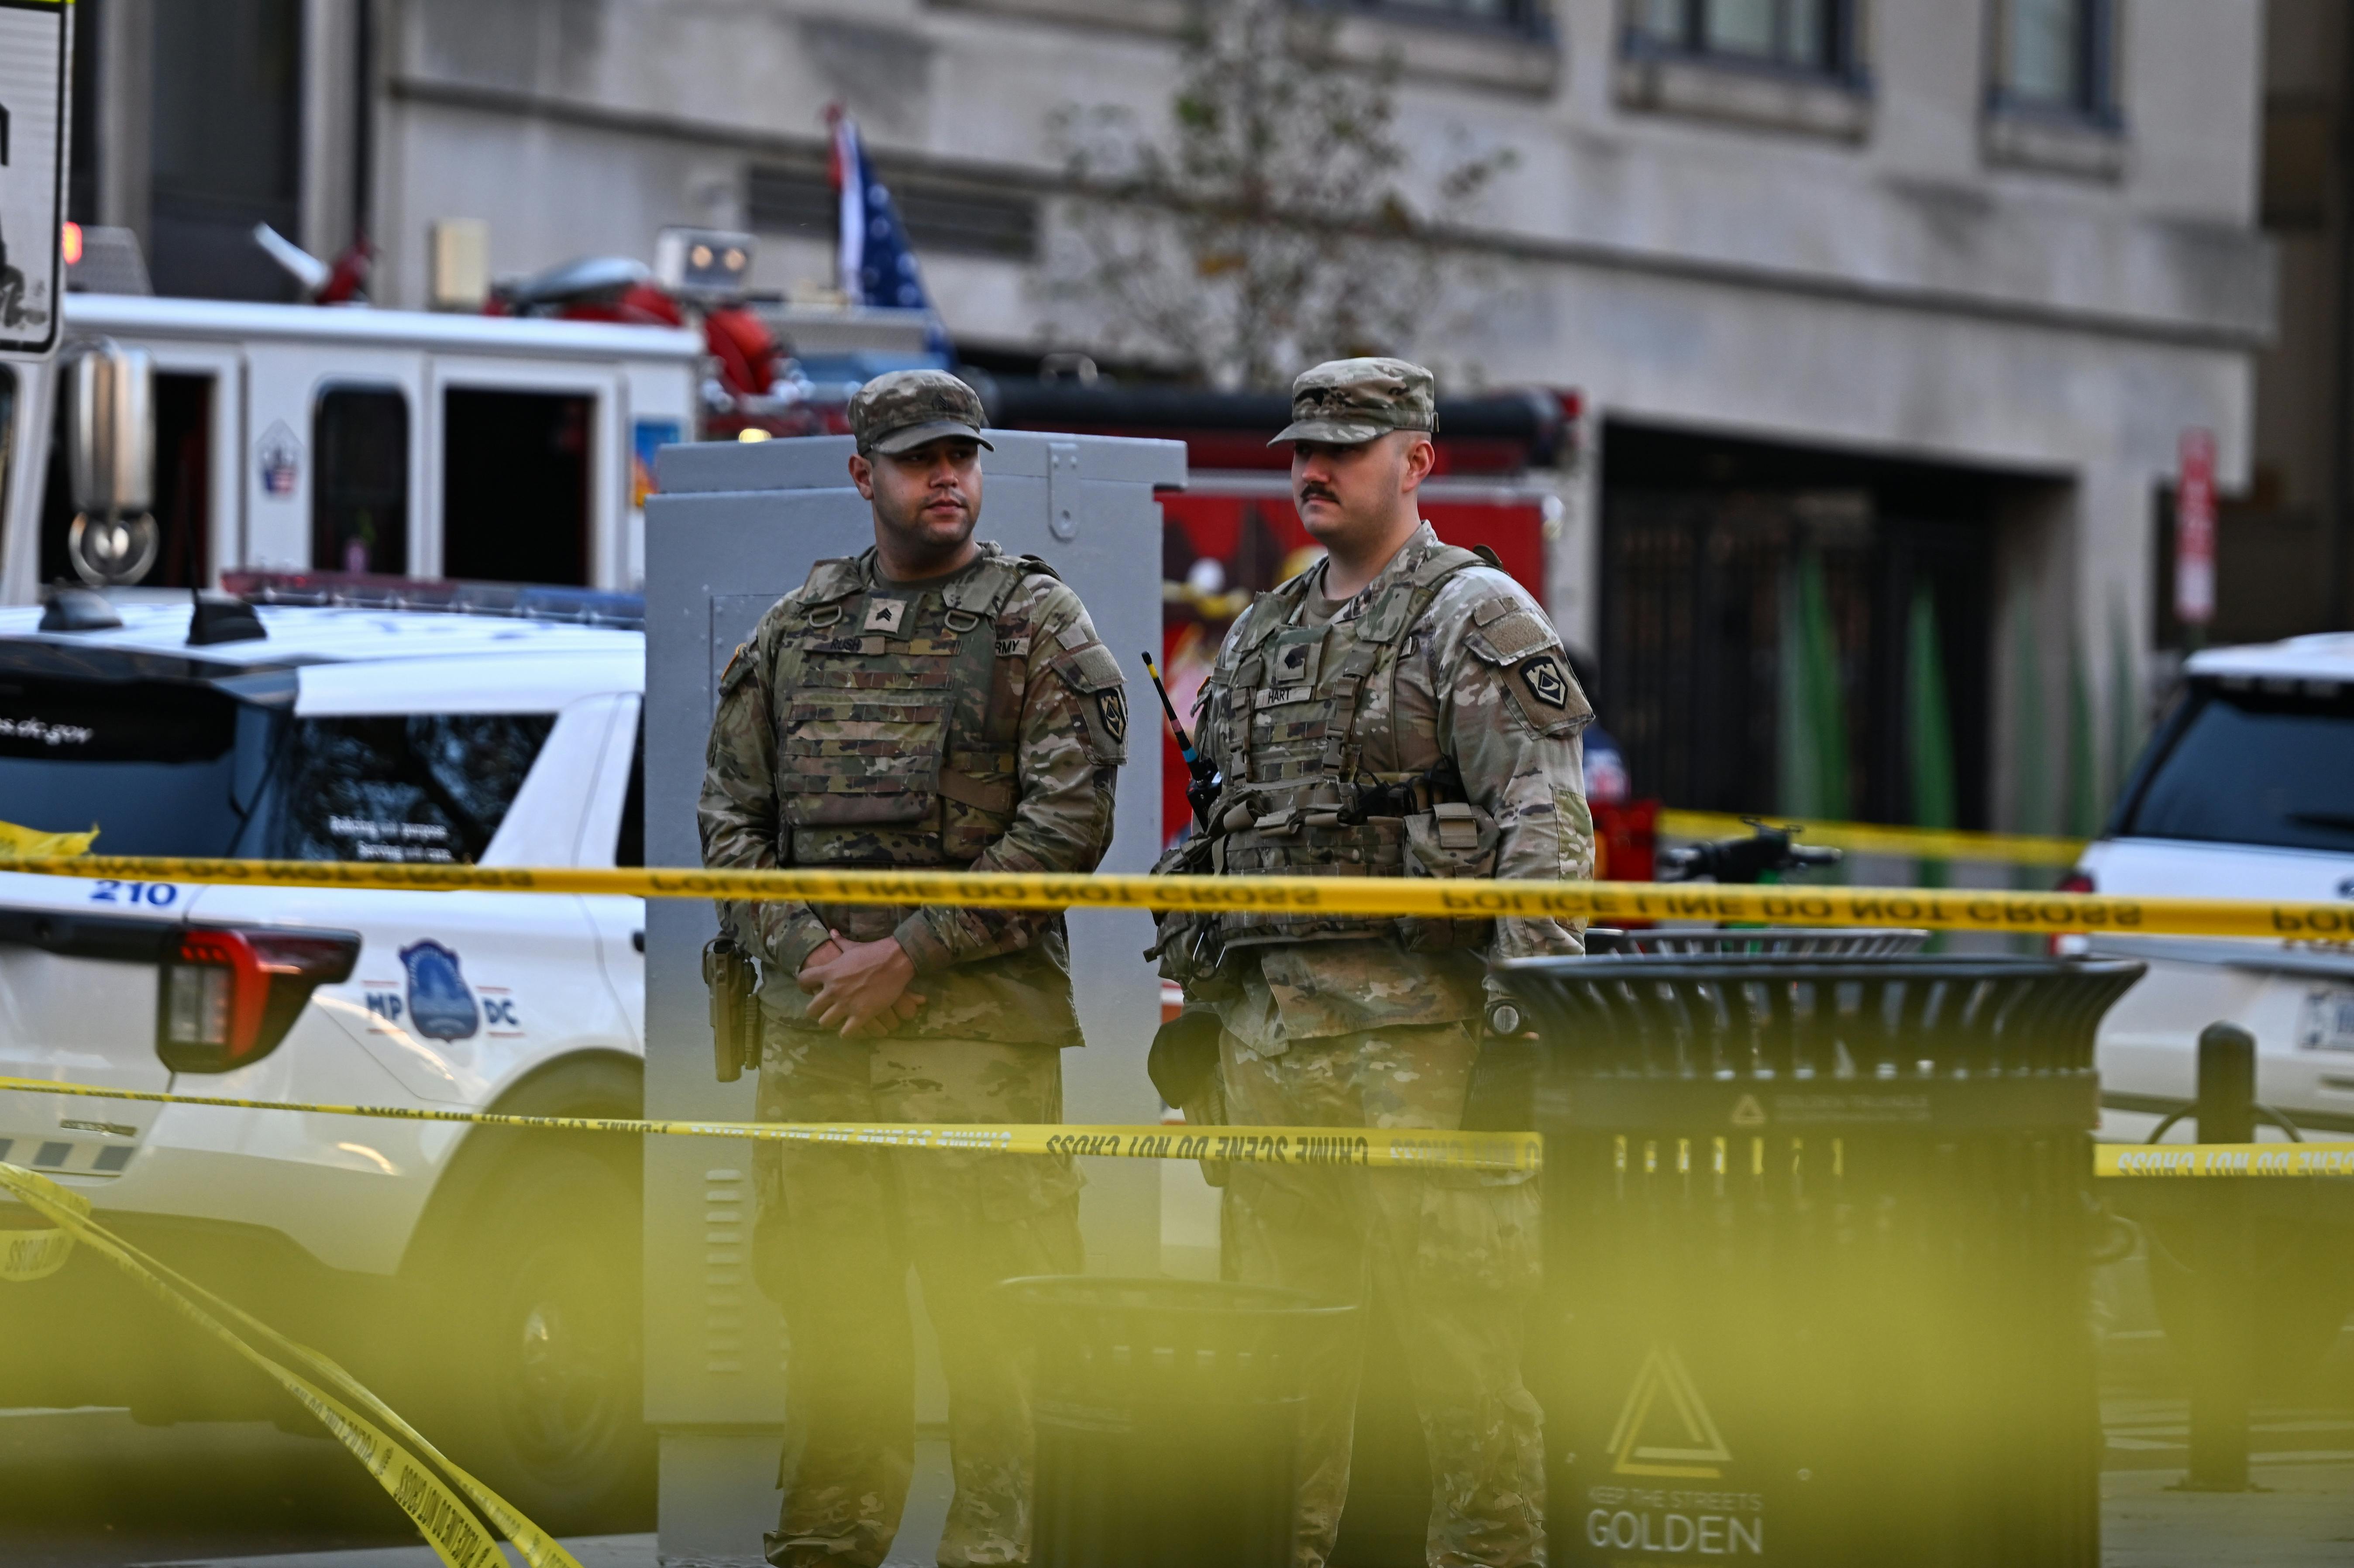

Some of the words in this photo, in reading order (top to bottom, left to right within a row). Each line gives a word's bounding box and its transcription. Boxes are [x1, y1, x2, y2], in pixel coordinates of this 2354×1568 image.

[830, 637, 861, 651] RUSH
[1268, 687, 1291, 704] HART
[90, 880, 177, 906] 210
[365, 992, 403, 1022] MP
[483, 997, 519, 1026] DC
[1176, 1135, 1209, 1160] DO
[1215, 1135, 1288, 1163] SCENE
[1295, 1136, 1369, 1165] CRIME
[1587, 1508, 1763, 1555] GOLDEN
